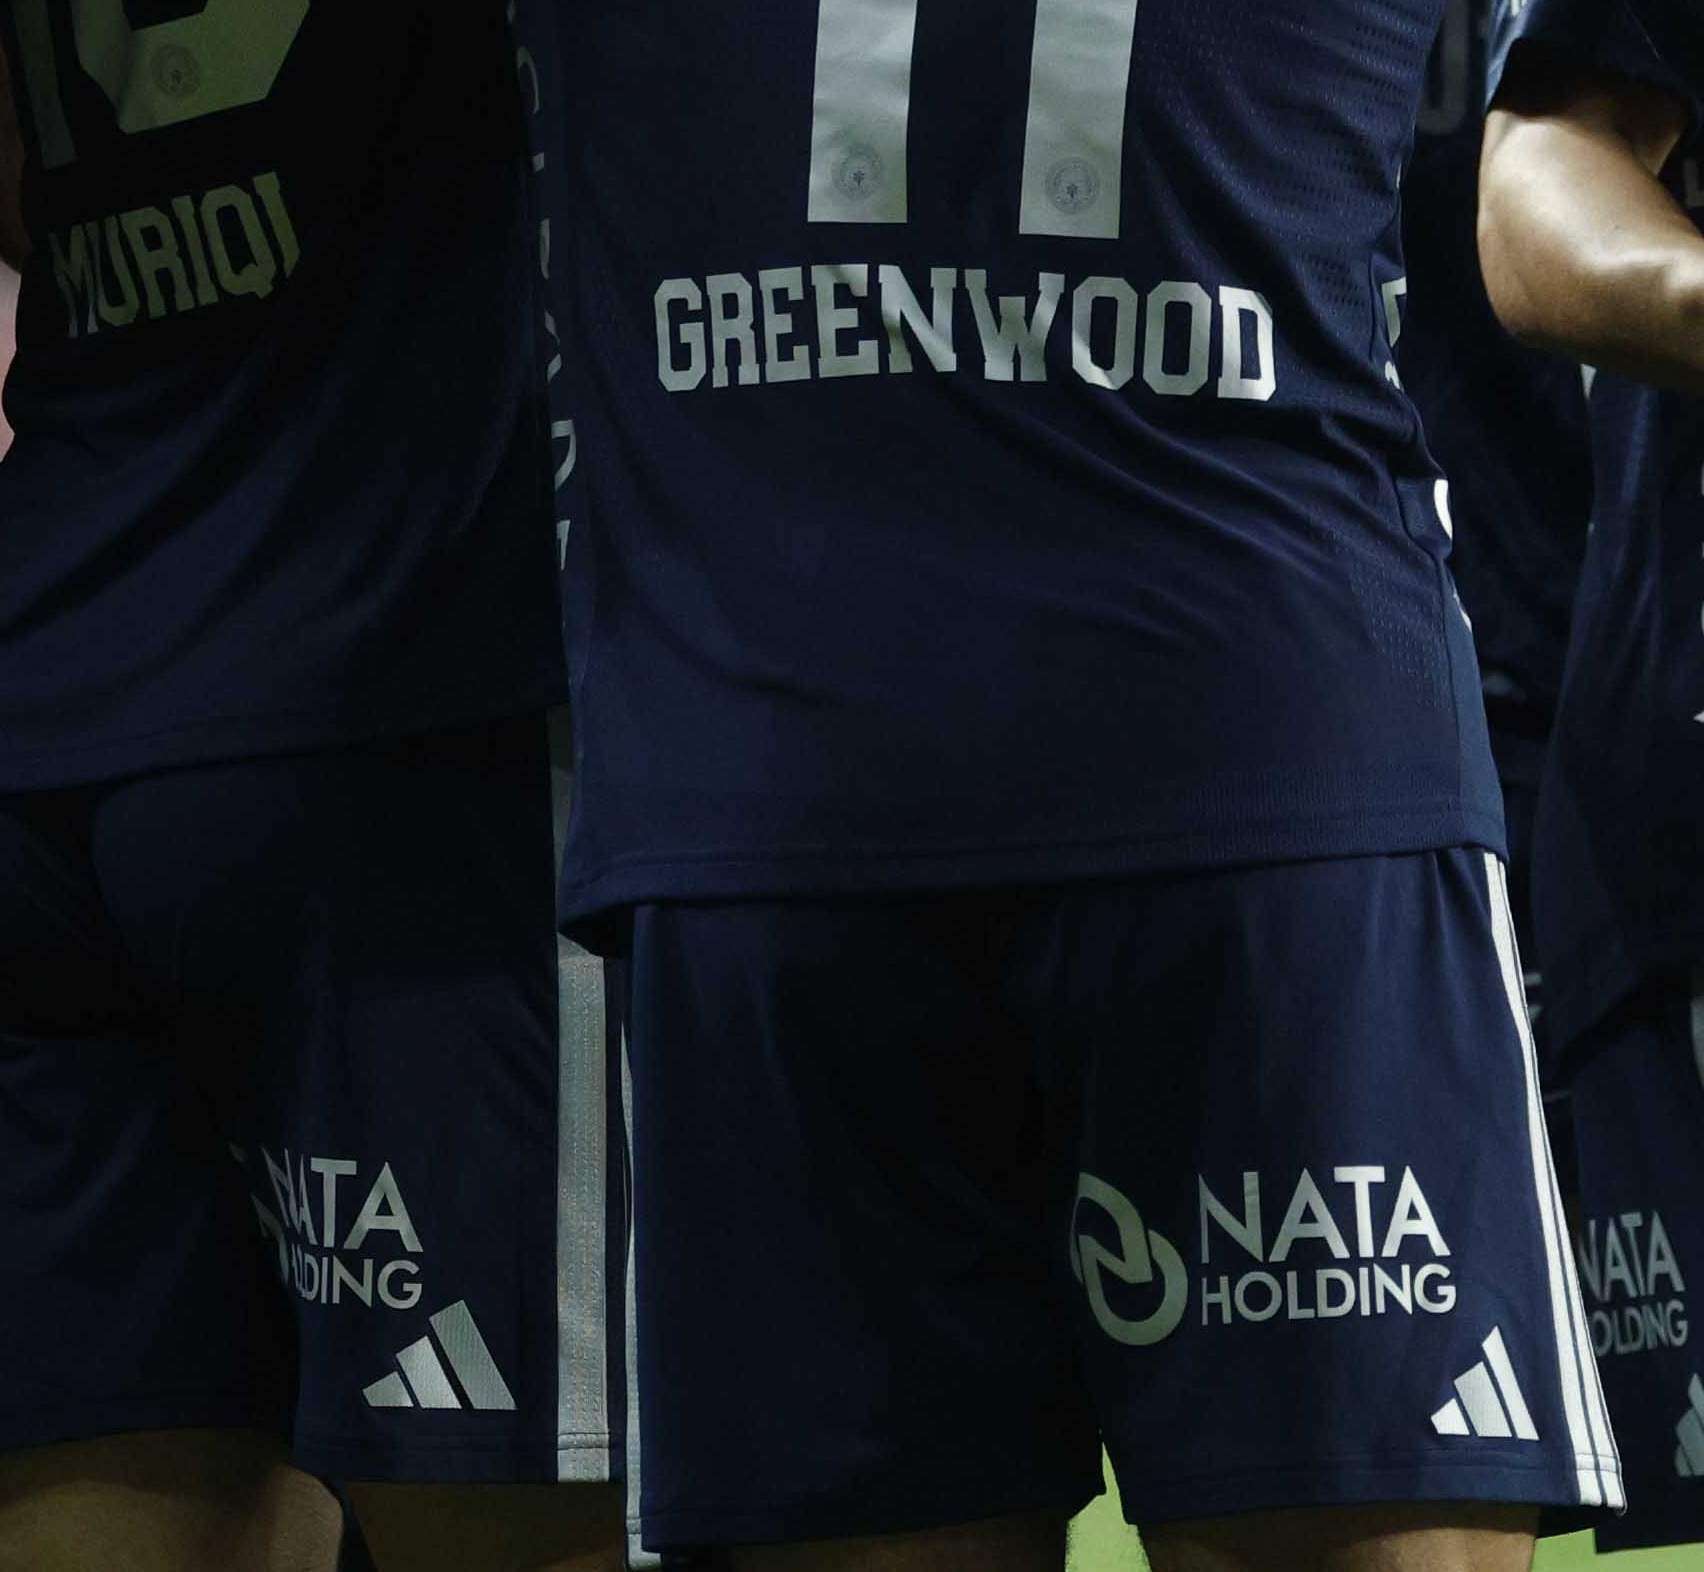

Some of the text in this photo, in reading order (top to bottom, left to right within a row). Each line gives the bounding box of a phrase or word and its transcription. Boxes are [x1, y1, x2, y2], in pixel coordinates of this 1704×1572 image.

[49, 171, 300, 339] MURIQI
[654, 262, 1277, 402] GREENWOOD
[1199, 1165, 1451, 1264] NATA
[1201, 1262, 1456, 1325] HOLDING
[1590, 1299, 1688, 1357] OLDING
